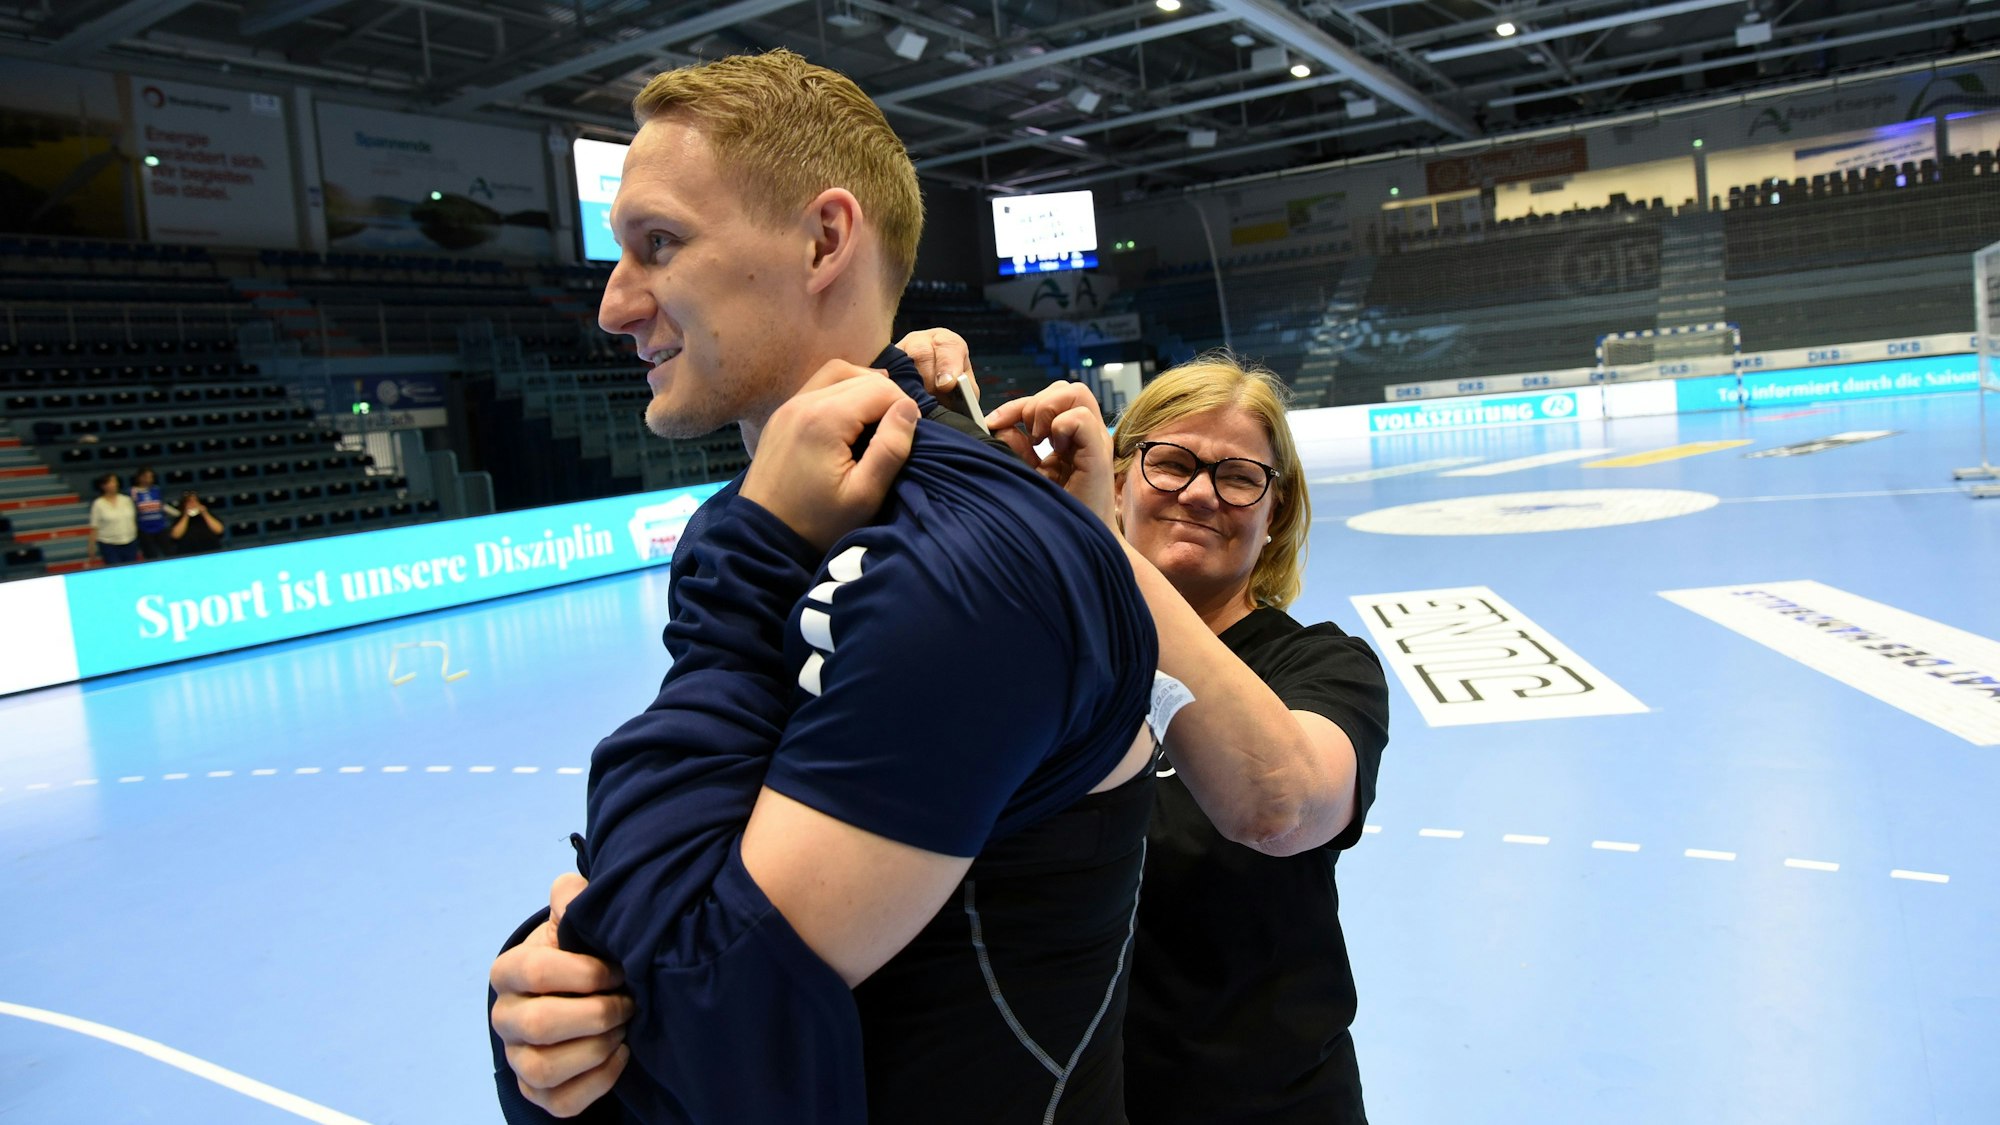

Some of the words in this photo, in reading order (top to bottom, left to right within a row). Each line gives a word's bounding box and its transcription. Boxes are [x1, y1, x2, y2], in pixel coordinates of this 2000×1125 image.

[1808, 350, 1840, 362] DKB
[1888, 341, 1921, 355] DKB
[1752, 379, 1840, 401] informiert
[1843, 374, 1892, 392] durch
[1895, 370, 1922, 388] die
[1374, 402, 1534, 431] VOLKSZEITUNG
[135, 578, 270, 643] Sport
[277, 571, 330, 614] ist
[340, 554, 467, 602] unsere
[475, 523, 614, 578] Disziplin
